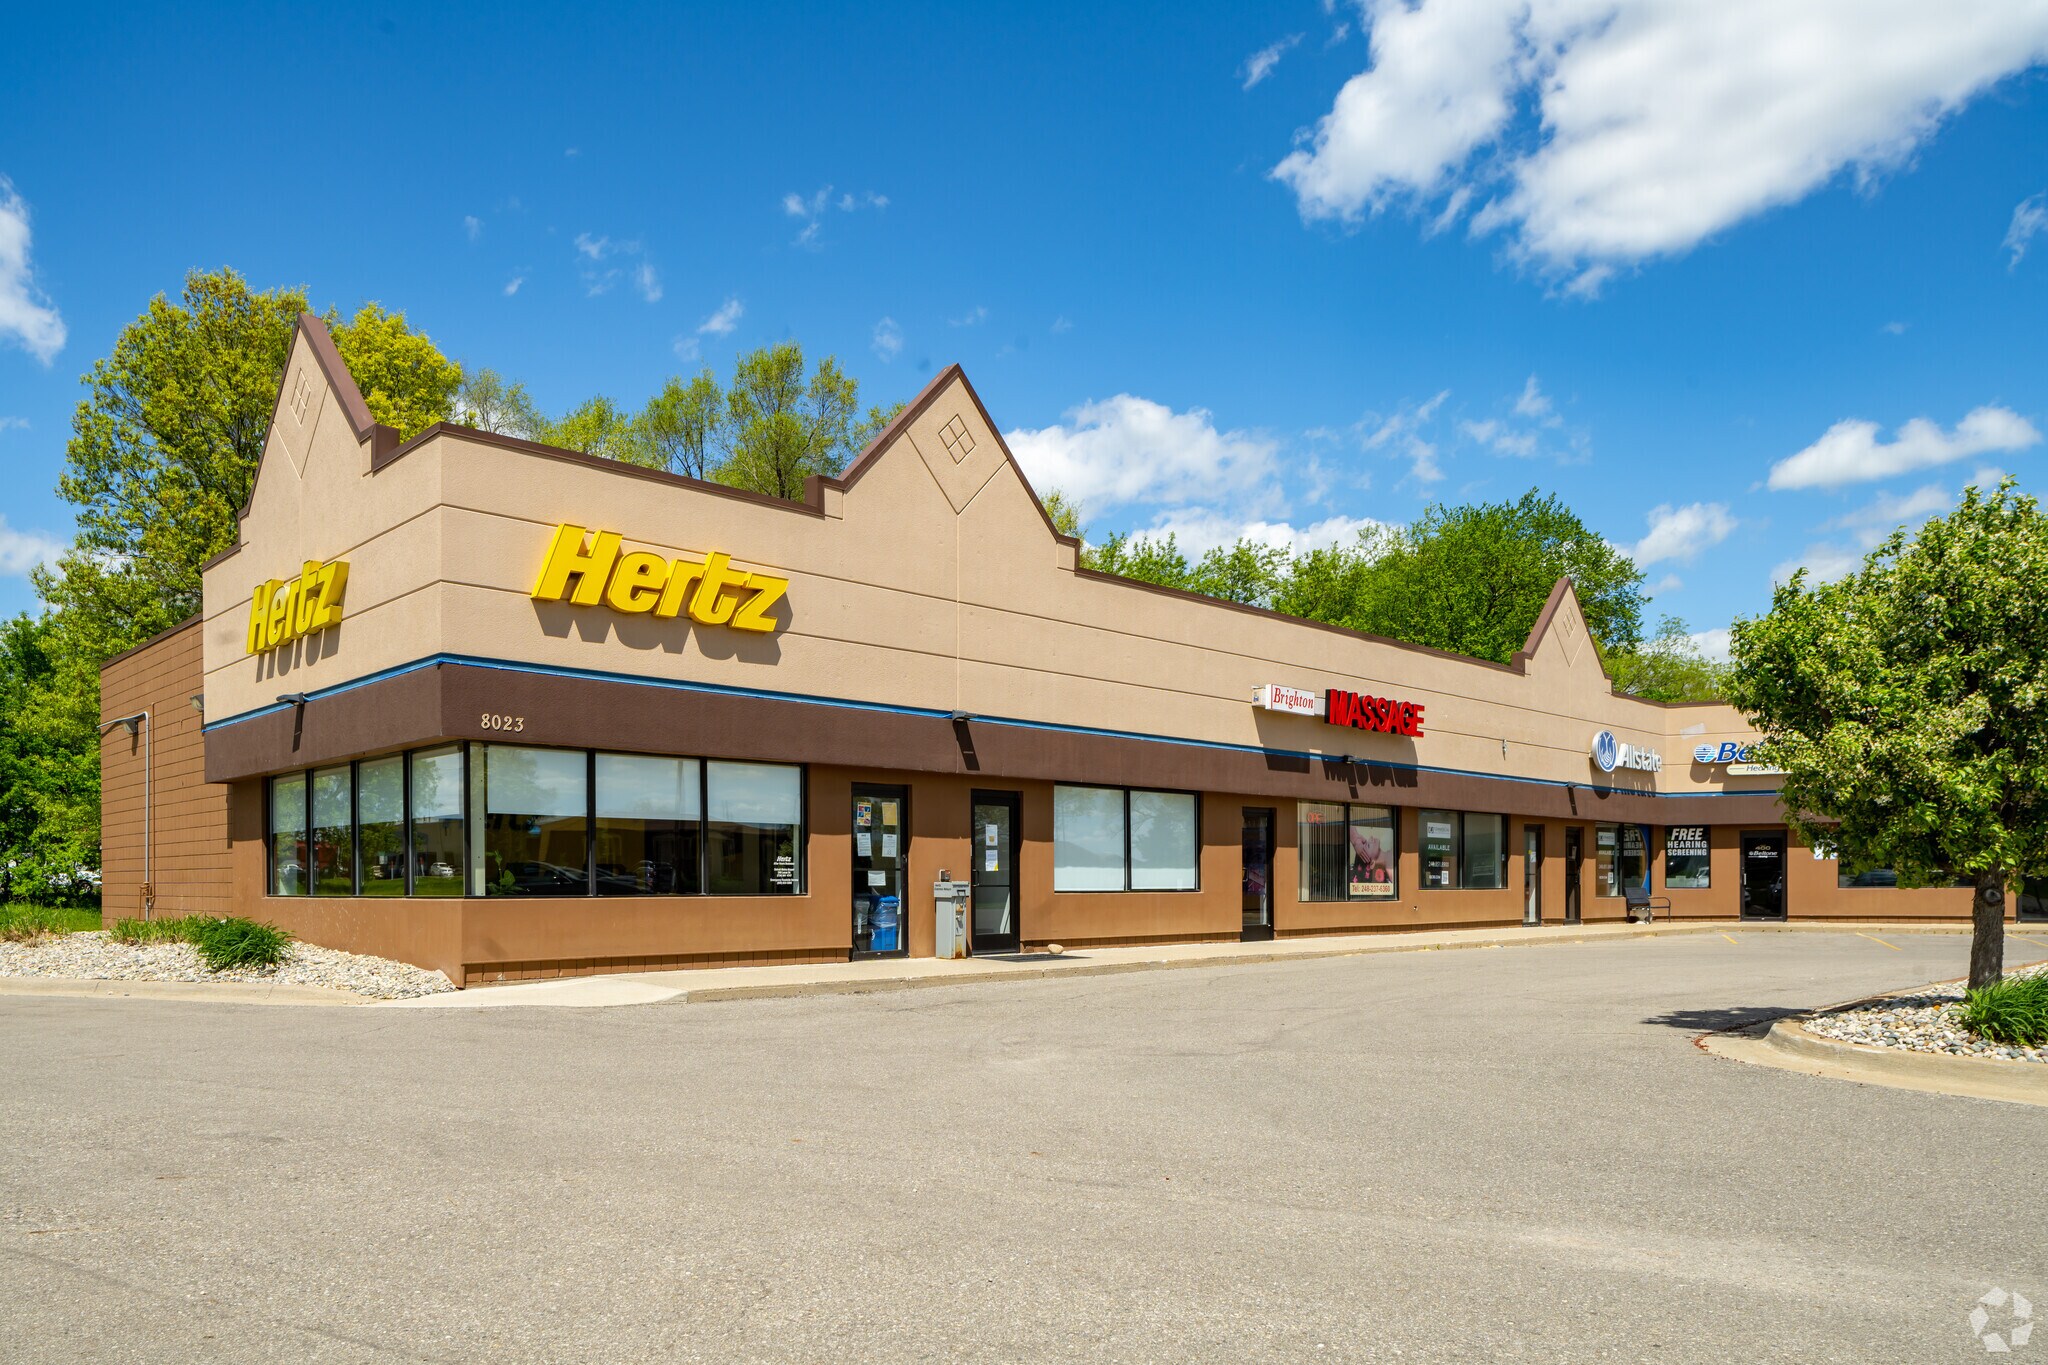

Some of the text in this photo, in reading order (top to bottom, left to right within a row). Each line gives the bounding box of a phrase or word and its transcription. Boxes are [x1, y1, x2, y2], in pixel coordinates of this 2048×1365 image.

[529, 522, 790, 633] Hertz
[246, 559, 350, 655] Hertz
[1273, 687, 1315, 710] Brighton
[480, 712, 525, 733] 8023
[1327, 688, 1426, 738] MASSAGE
[1620, 743, 1662, 772] Allstate
[1667, 840, 1707, 849] HEARING
[1670, 828, 1704, 841] FREE
[1667, 848, 1707, 856] SCREENING
